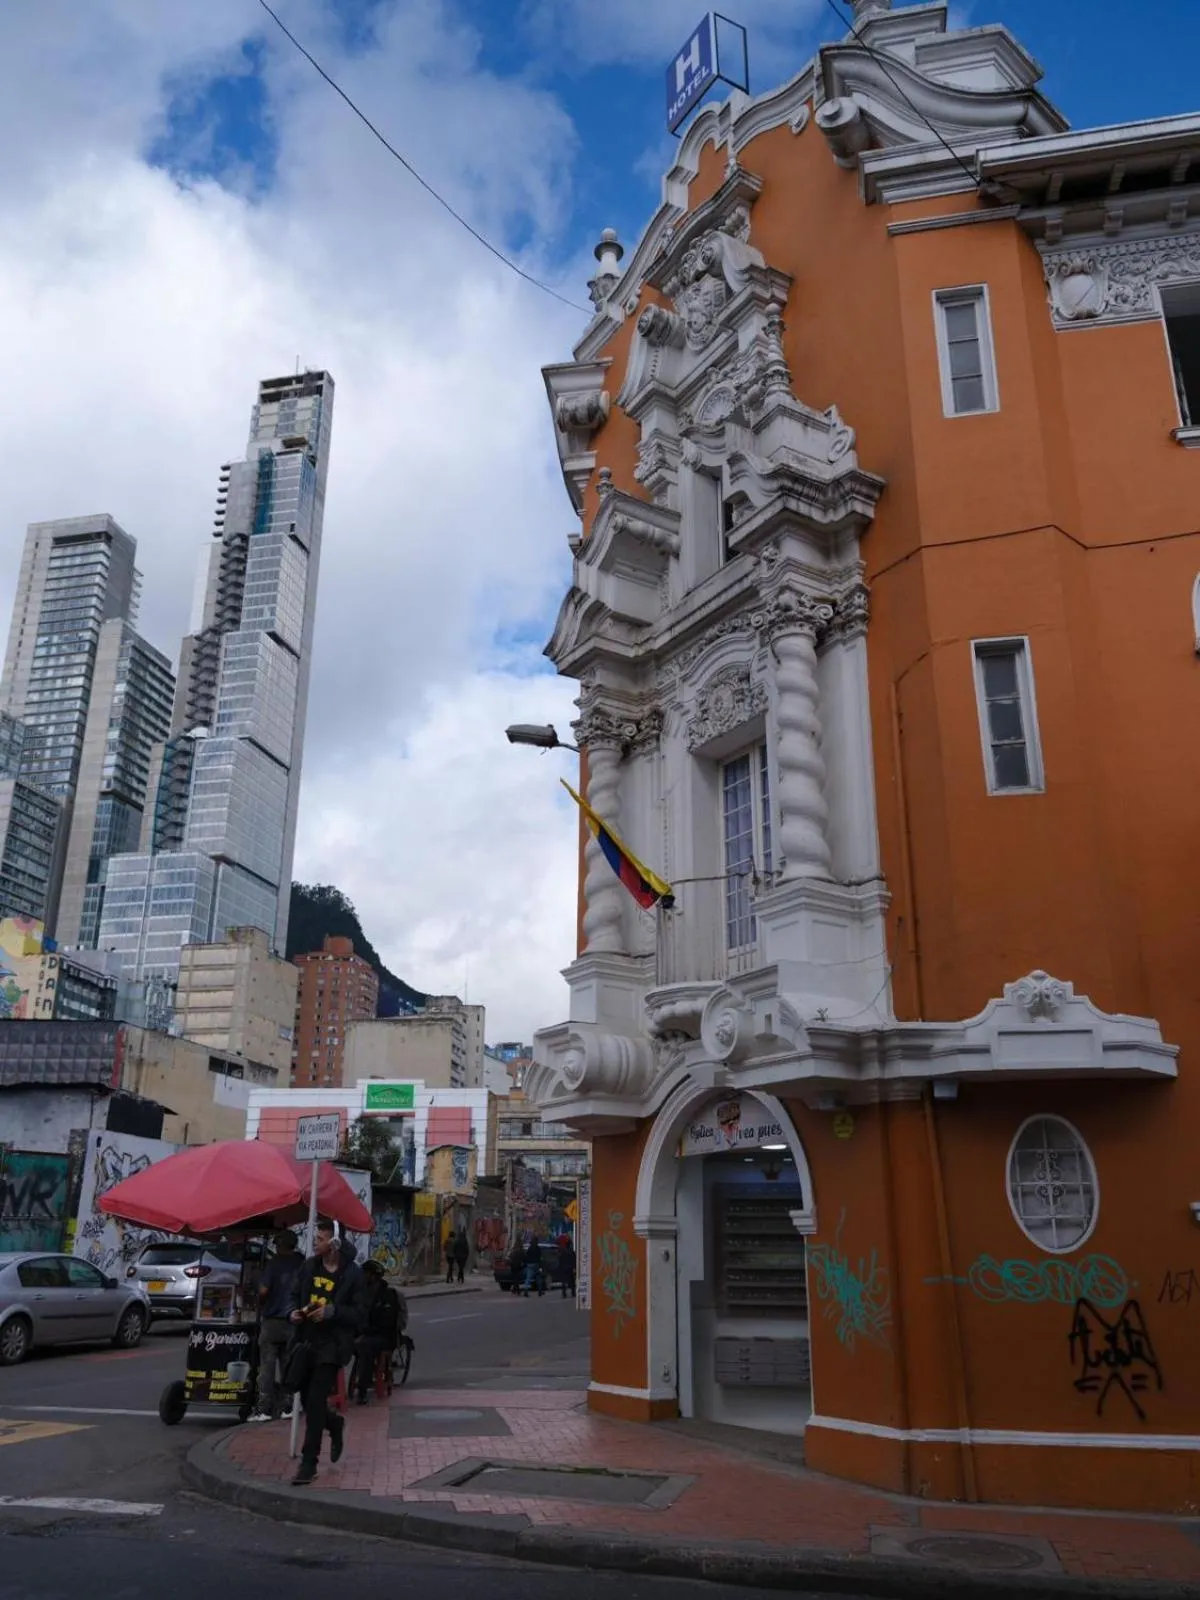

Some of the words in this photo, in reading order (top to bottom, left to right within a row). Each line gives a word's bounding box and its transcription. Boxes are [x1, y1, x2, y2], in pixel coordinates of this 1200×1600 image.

[674, 33, 701, 94] H
[667, 65, 710, 121] HOTEL
[205, 1331, 250, 1352] Barista
